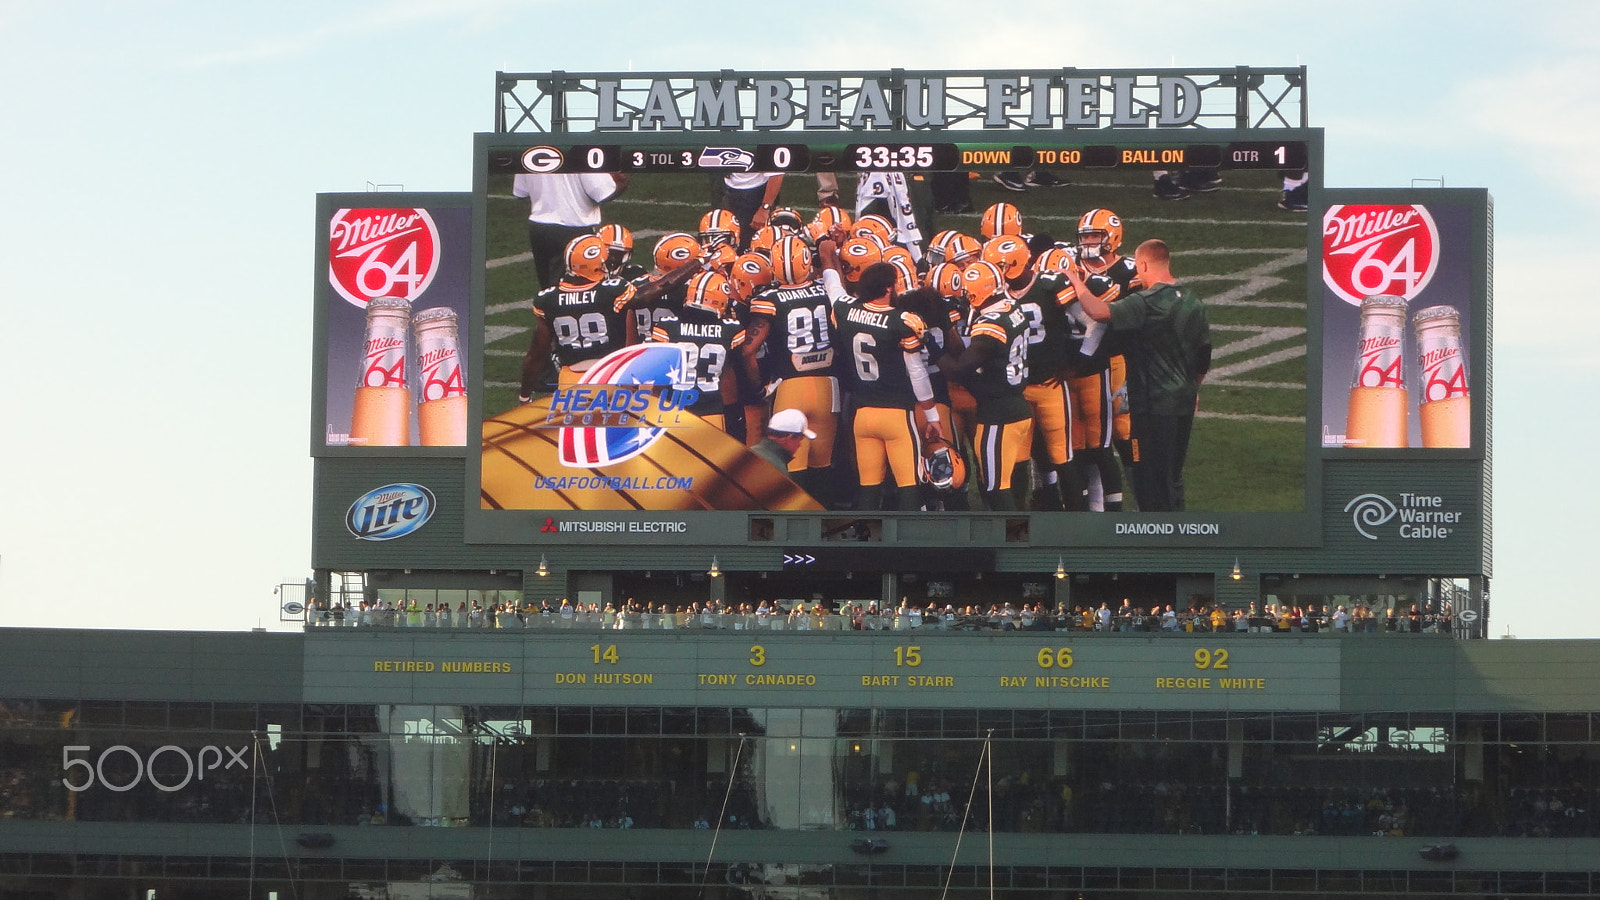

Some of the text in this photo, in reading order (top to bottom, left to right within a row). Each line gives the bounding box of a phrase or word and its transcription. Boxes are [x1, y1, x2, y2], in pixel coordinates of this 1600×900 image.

[597, 76, 1202, 132] LAMBEAU FIELD
[587, 147, 604, 168] 0
[632, 152, 693, 166] 3 TOL 3
[774, 147, 791, 168] 0
[855, 146, 934, 168] 33:35
[962, 150, 1011, 164] DOWN
[1037, 150, 1081, 164] TO GO
[1122, 149, 1184, 163] BALL ON
[1232, 151, 1259, 163] QTR
[1273, 147, 1286, 164] 1
[331, 213, 421, 251] Miller
[1323, 209, 1419, 248] Miller
[356, 240, 424, 299] 64
[1351, 237, 1422, 296] 64
[558, 290, 597, 306] FINLEY
[847, 307, 889, 329] HARRELL
[680, 322, 723, 338] WALKER
[787, 304, 832, 354] 81
[366, 337, 404, 354] Miller
[1361, 336, 1401, 353] Miller
[419, 347, 456, 367] Miller
[852, 332, 880, 382] 6
[1420, 346, 1458, 366] Miller
[364, 356, 406, 389] 64
[1359, 355, 1403, 389] 64
[423, 363, 466, 403] 64
[1425, 363, 1469, 403] 64
[549, 388, 700, 413] HEADS UP
[546, 413, 682, 425] FOOTBALL
[534, 476, 694, 491] USAFOOTBALL.COM
[374, 490, 406, 505] Miller
[1400, 492, 1442, 508] Time
[360, 497, 424, 538] Lite
[1399, 508, 1462, 524] Warner
[559, 521, 687, 533] MITSUBISHI ELECTRIC
[1115, 523, 1219, 535] DIAMOND VISION
[590, 644, 620, 665] 14
[749, 645, 766, 666] 3
[893, 645, 922, 667] 15
[1037, 646, 1074, 669] 66
[1194, 647, 1230, 669] 92
[374, 661, 511, 673] RETIRED NUMBERS
[555, 673, 653, 685] DON HUTSON
[698, 674, 816, 686] TONY CANADEO
[862, 675, 954, 687] BART STARR
[1000, 676, 1110, 688] RAY NITSCHKE
[1155, 677, 1265, 689] REGGIE WHITE
